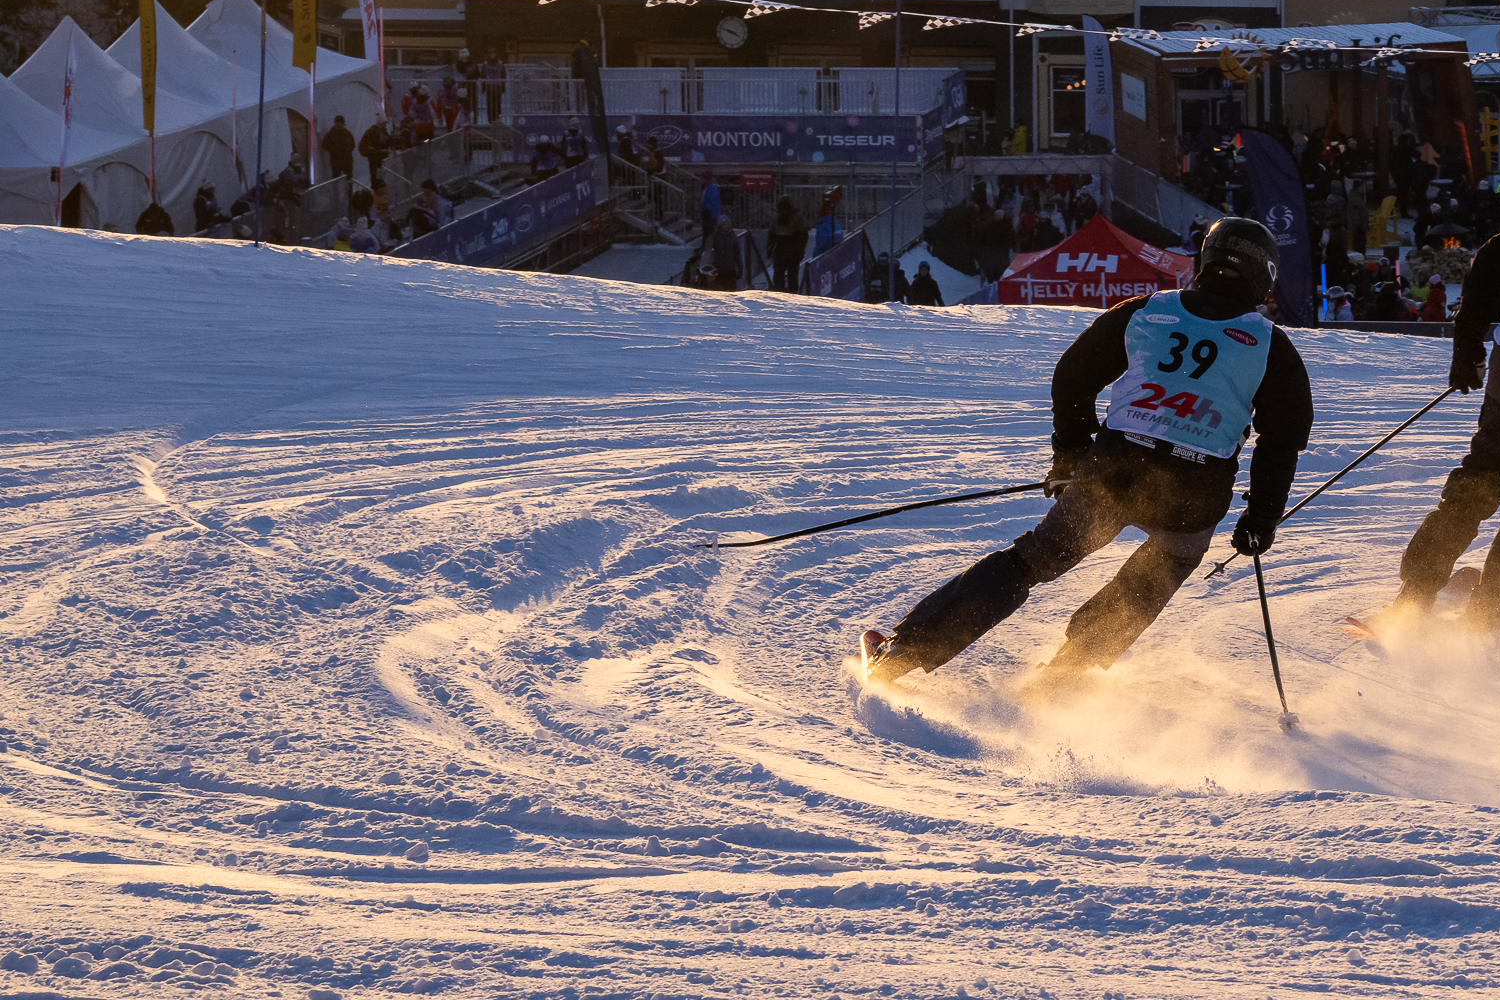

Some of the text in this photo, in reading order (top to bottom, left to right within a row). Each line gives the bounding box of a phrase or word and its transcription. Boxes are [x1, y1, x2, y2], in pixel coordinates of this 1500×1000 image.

[1094, 45, 1106, 95] Sun Life
[1277, 41, 1344, 72] Sun
[697, 131, 782, 147] MONTONI
[816, 134, 896, 146] TISSEUR
[1020, 282, 1158, 298] HELLY HANSEN
[1157, 331, 1219, 380] 39
[1130, 383, 1222, 430] 24h
[1126, 409, 1214, 438] TREMBLANT
[1172, 446, 1197, 459] GROUPE
